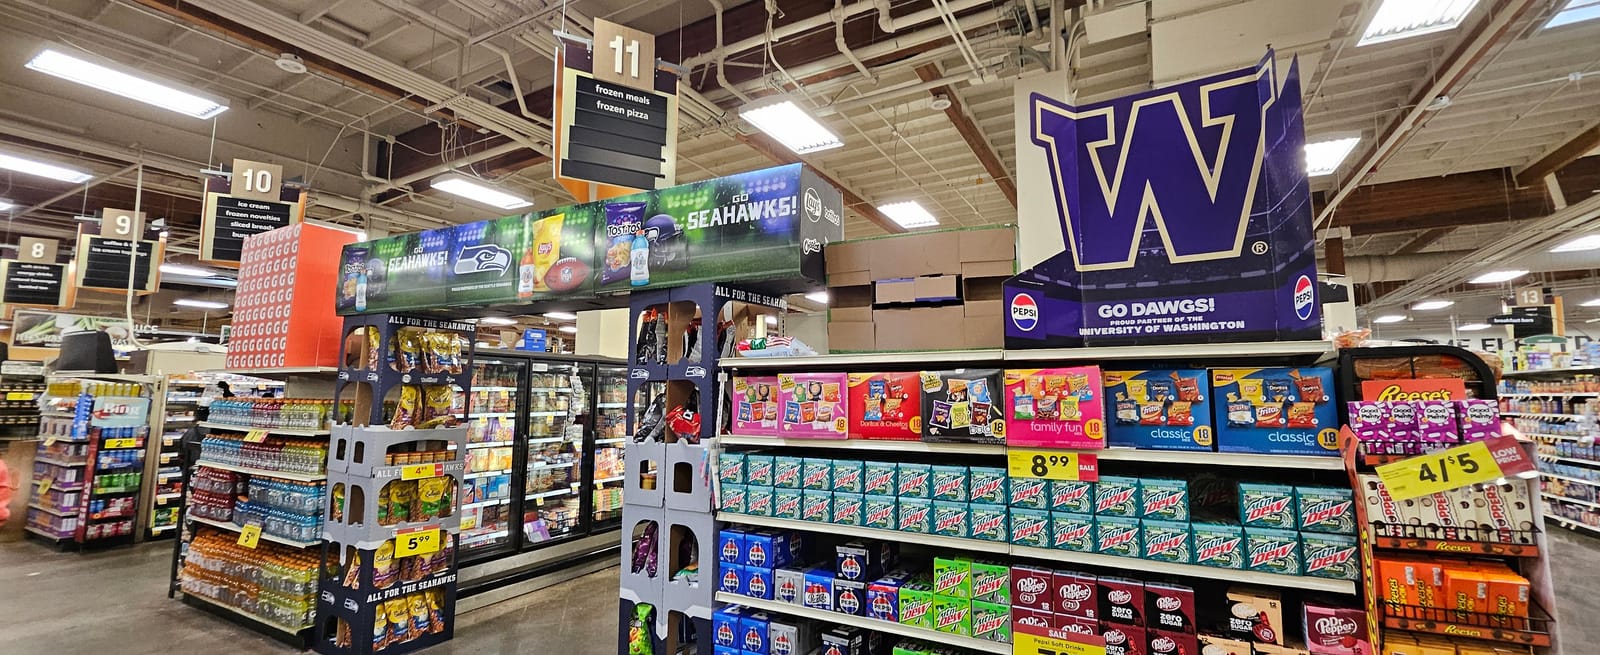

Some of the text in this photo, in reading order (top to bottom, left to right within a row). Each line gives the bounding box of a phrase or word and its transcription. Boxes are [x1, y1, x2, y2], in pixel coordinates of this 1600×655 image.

[609, 35, 639, 78] 11
[595, 84, 650, 105] frozen meals
[596, 100, 649, 120] frozen pizza
[1035, 56, 1276, 272] W
[242, 168, 272, 193] 10
[237, 200, 248, 208] ice
[732, 193, 749, 204] GO
[225, 210, 281, 222] frozen novelties
[687, 195, 797, 230] SEAHAWKS!
[115, 215, 131, 235] 9
[230, 221, 251, 229] sliced
[31, 242, 45, 258] 8
[715, 285, 731, 298] ALL
[732, 289, 746, 300] FOR
[747, 292, 761, 304] THE
[1294, 291, 1314, 305] PEPSI
[1521, 290, 1539, 304] 13
[1012, 307, 1038, 318] PEPSI
[1098, 298, 1215, 319] GO DAWGS!
[388, 316, 475, 332] ALL FOR THE SEAHAWKS
[1109, 319, 1136, 327] PROUD
[1136, 317, 1173, 325] PARTNER
[1186, 315, 1204, 323] THE
[1078, 320, 1245, 336] UNIVERSITY OF WASHINGTON
[1377, 385, 1452, 401] Reese's
[837, 419, 845, 428] 18
[993, 422, 1004, 432] 18
[1030, 421, 1083, 435] family fun
[1089, 422, 1100, 433] 18
[1150, 428, 1191, 439] classic
[1197, 428, 1209, 439] 18
[1268, 431, 1315, 443] classic
[1323, 432, 1337, 443] 18
[1492, 446, 1517, 458] LOW
[1496, 454, 1522, 465] PRICE
[1031, 455, 1069, 477] 8 99
[376, 469, 392, 478] ALL
[407, 537, 418, 550] 5
[1018, 578, 1045, 593] Pepper
[1026, 577, 1038, 587] Dr
[1069, 583, 1081, 593] Dr
[366, 573, 456, 604] ALL FOR THE SEAHAWKS
[1061, 585, 1089, 600] Pepper
[1085, 609, 1094, 618] 12
[1111, 605, 1132, 615] zero
[1111, 612, 1133, 620] SUGAR
[1159, 612, 1182, 622] zero
[1160, 619, 1183, 627] SUGAR
[1229, 617, 1252, 626] zero
[1329, 616, 1344, 626] Dr
[1319, 618, 1355, 635] Pepper
[1048, 629, 1068, 640] SALE
[1033, 638, 1085, 652] Pepsi Soft Drinks
